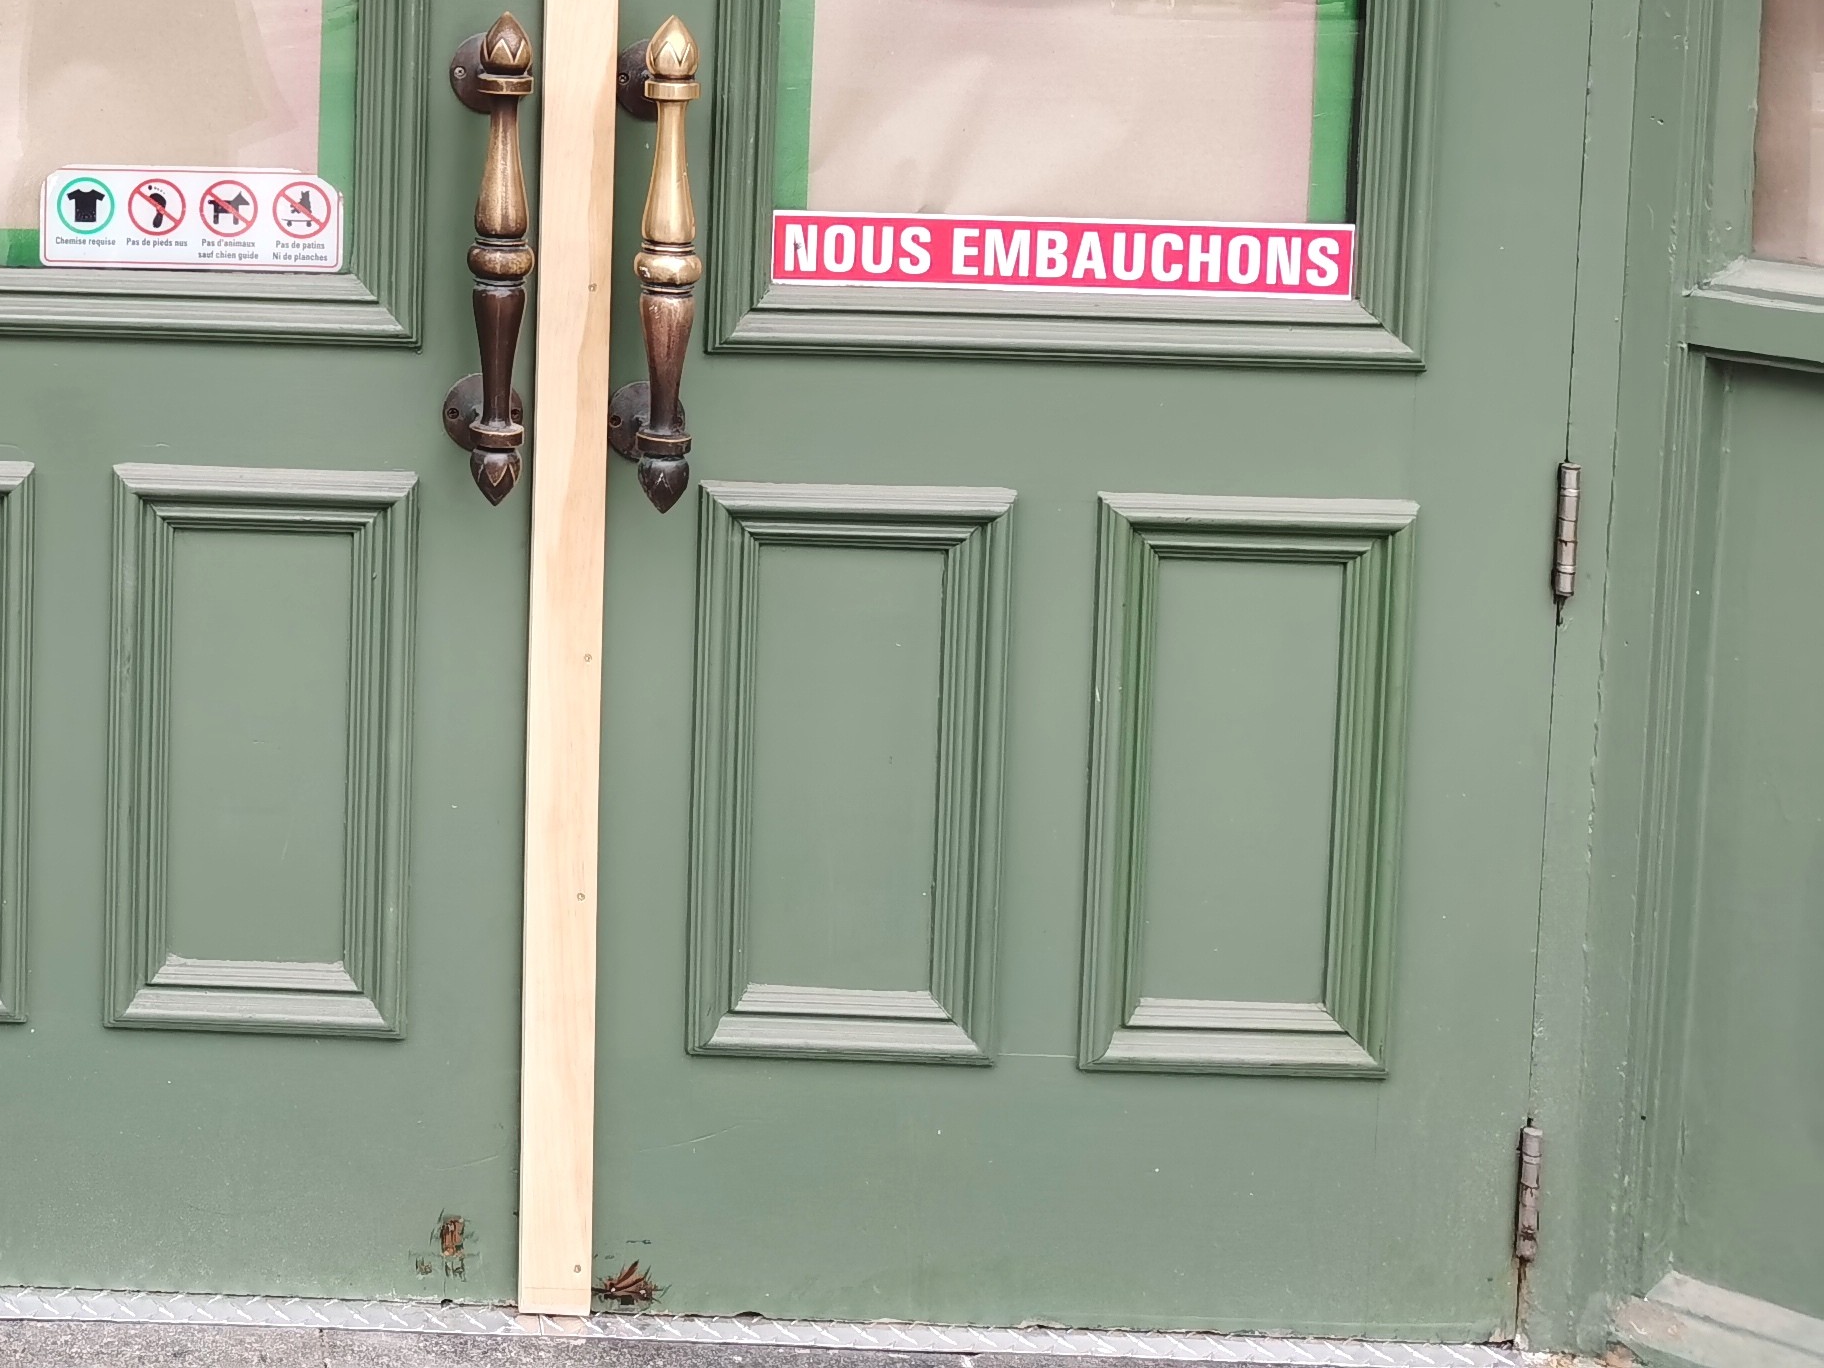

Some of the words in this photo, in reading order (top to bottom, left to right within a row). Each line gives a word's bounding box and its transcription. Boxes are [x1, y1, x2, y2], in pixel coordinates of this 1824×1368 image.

[55, 236, 86, 246] Chemise
[88, 236, 116, 248] requise
[126, 237, 140, 246] Pas
[141, 237, 152, 246] de
[153, 237, 173, 248] pieds
[201, 239, 214, 248] Pas
[216, 239, 256, 248] d'animaux
[275, 240, 289, 249] Pas
[290, 241, 301, 249] de
[302, 241, 325, 251] patins
[198, 250, 214, 259] sauf
[215, 250, 236, 260] chien
[237, 251, 259, 262] guide
[272, 252, 281, 261] Ni
[283, 252, 293, 261] de
[294, 252, 328, 263] planches
[783, 223, 932, 275] NOUS
[951, 227, 1341, 287] EMBAUCHONS
